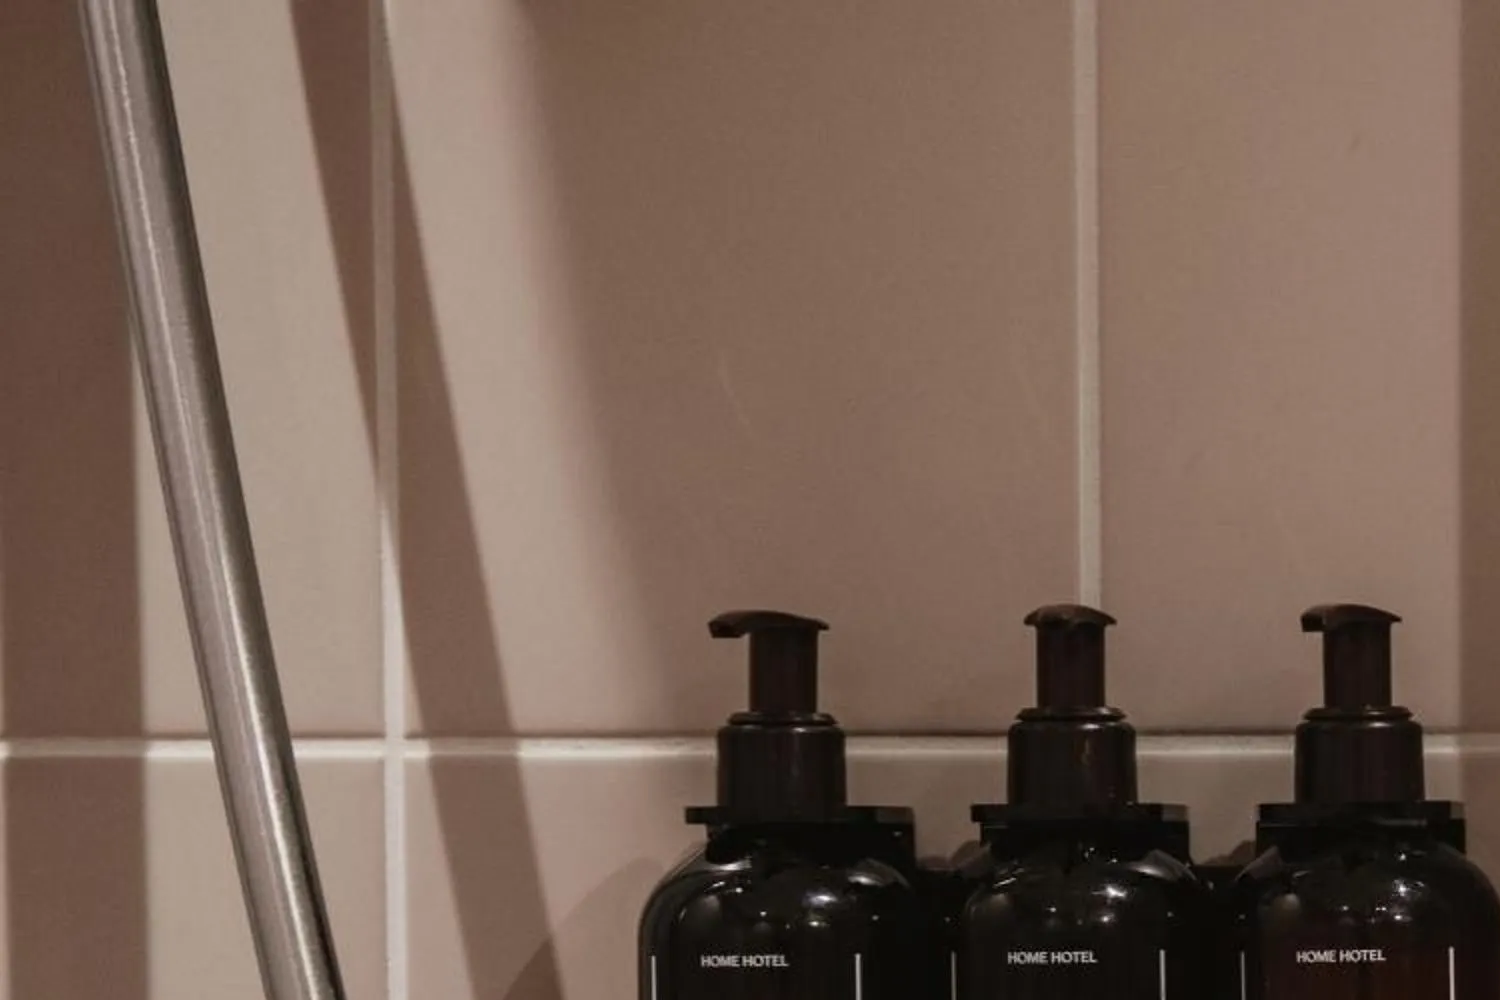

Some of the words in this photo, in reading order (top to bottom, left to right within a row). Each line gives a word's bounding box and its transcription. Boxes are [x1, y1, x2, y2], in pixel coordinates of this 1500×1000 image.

[700, 954, 741, 968] HOME
[742, 954, 789, 968] HOTEL
[1007, 950, 1048, 964] HOME
[1051, 950, 1098, 964] HOTEL
[1296, 949, 1337, 963] HOME
[1339, 949, 1386, 963] HOTEL
